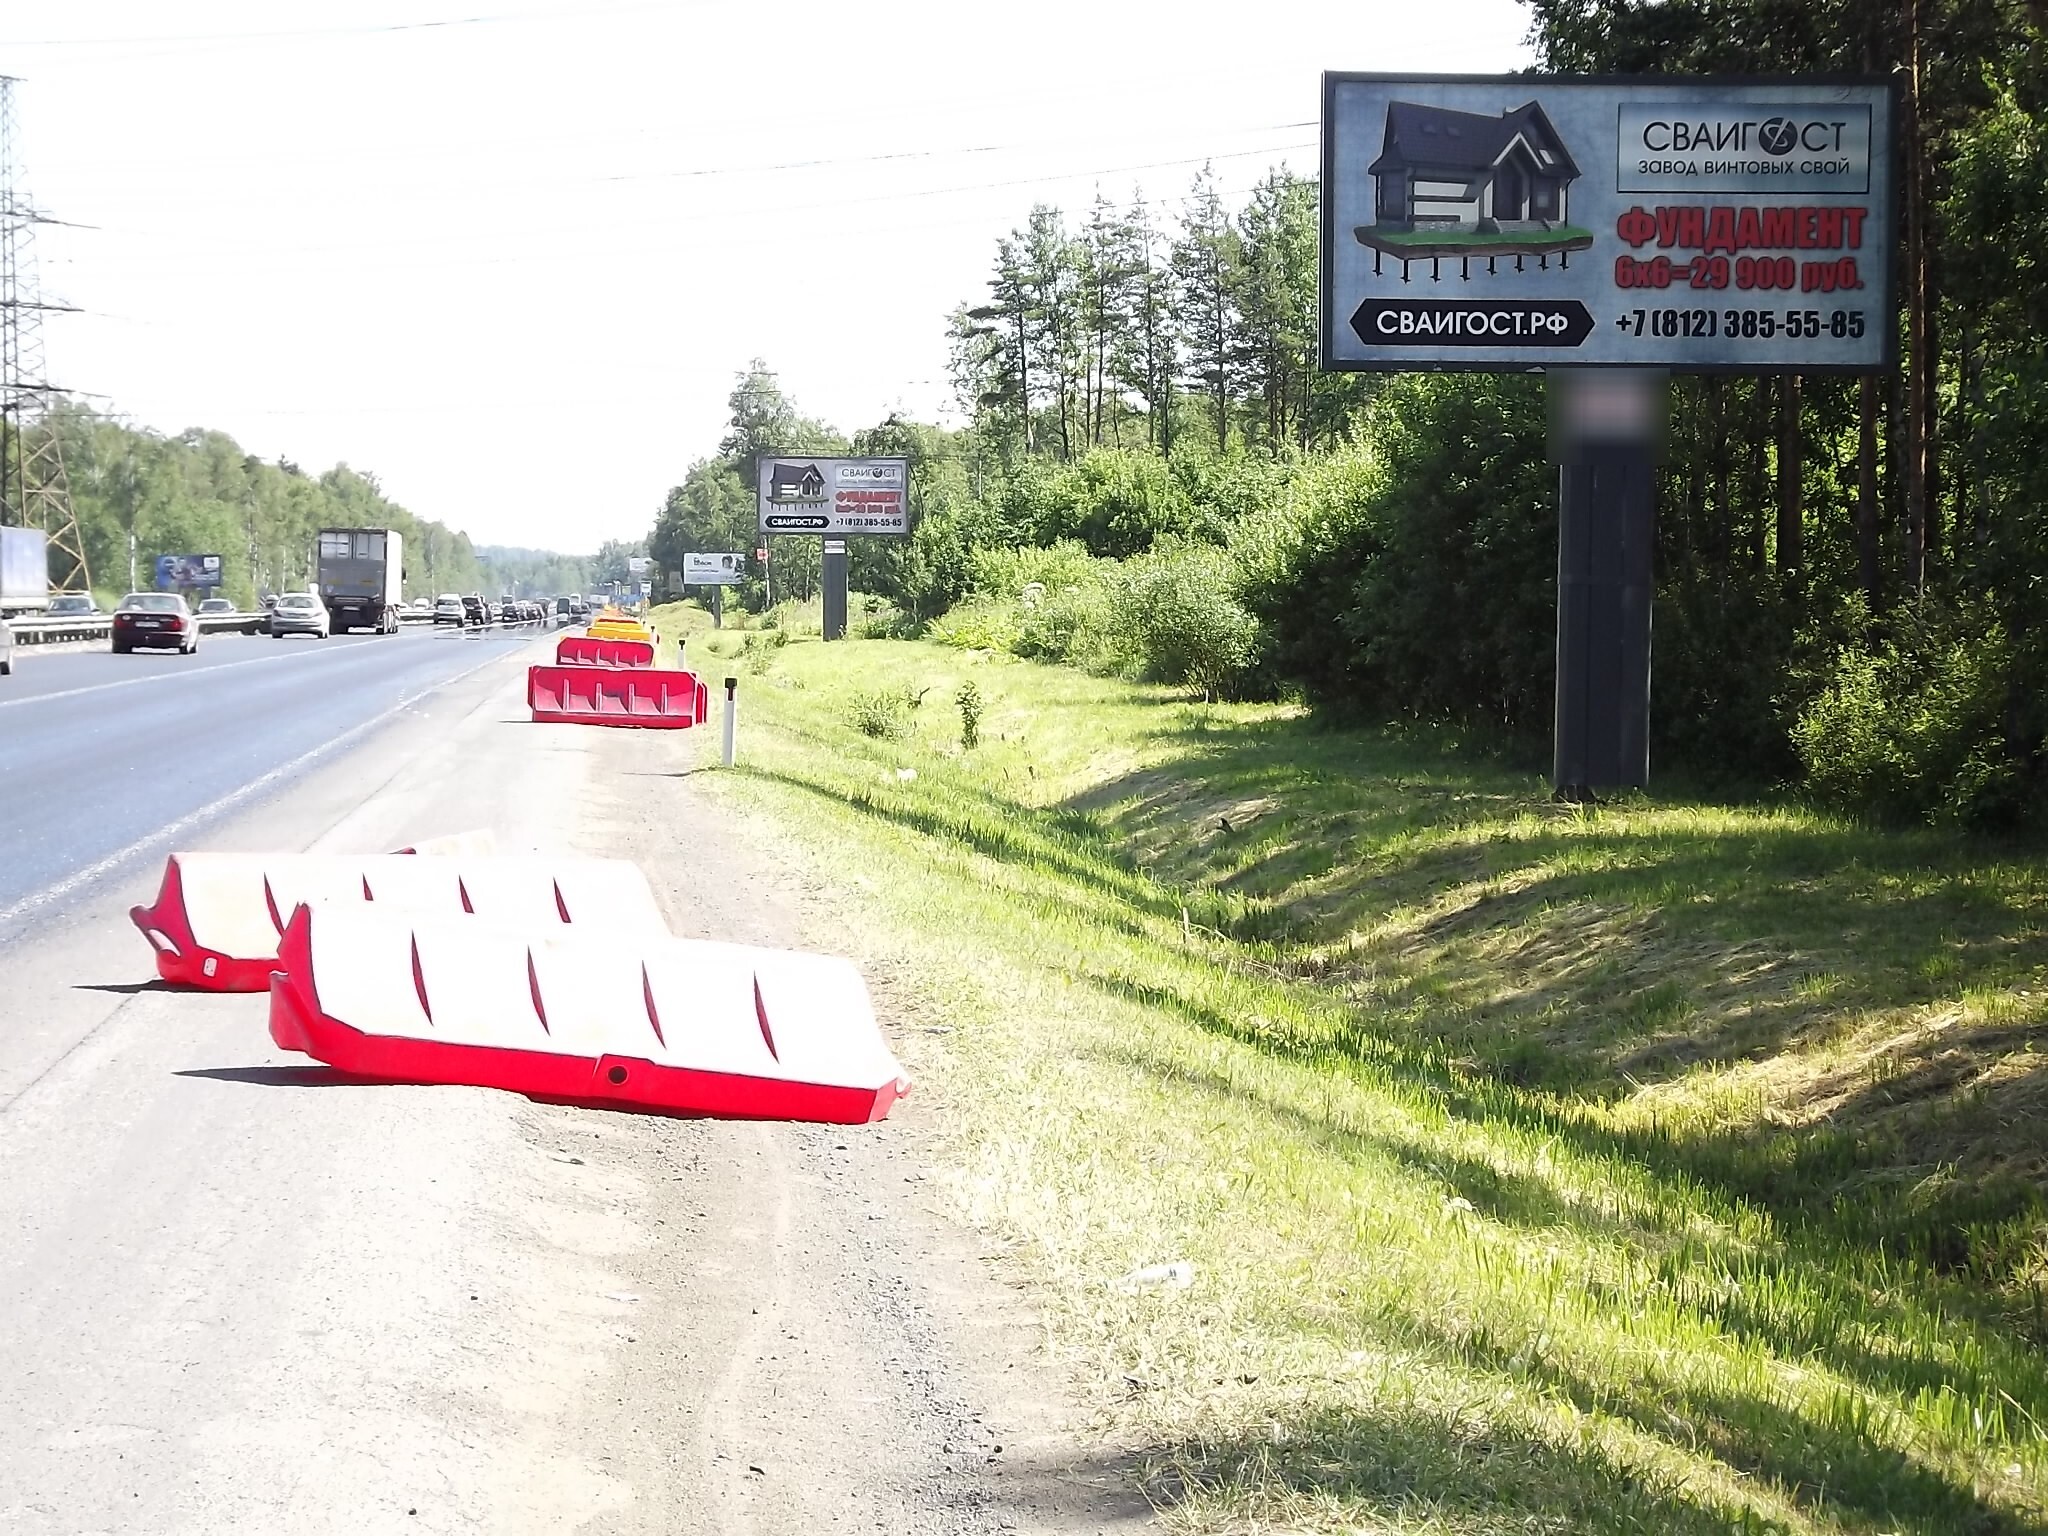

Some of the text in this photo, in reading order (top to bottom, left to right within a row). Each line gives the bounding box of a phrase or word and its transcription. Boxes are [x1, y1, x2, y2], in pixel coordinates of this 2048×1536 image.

[1643, 117, 1846, 156] СВАИГОСТ
[1617, 207, 1867, 255] ФУНДАМЕНТ
[1736, 256, 1795, 290] 900
[1801, 258, 1864, 292] руб.
[1376, 310, 1569, 335] СВАИГОСТ.РФ
[1616, 309, 1865, 338] +7 (812) 385-55-85
[841, 467, 896, 478] СВАИГОСТ
[836, 518, 844, 526] +7
